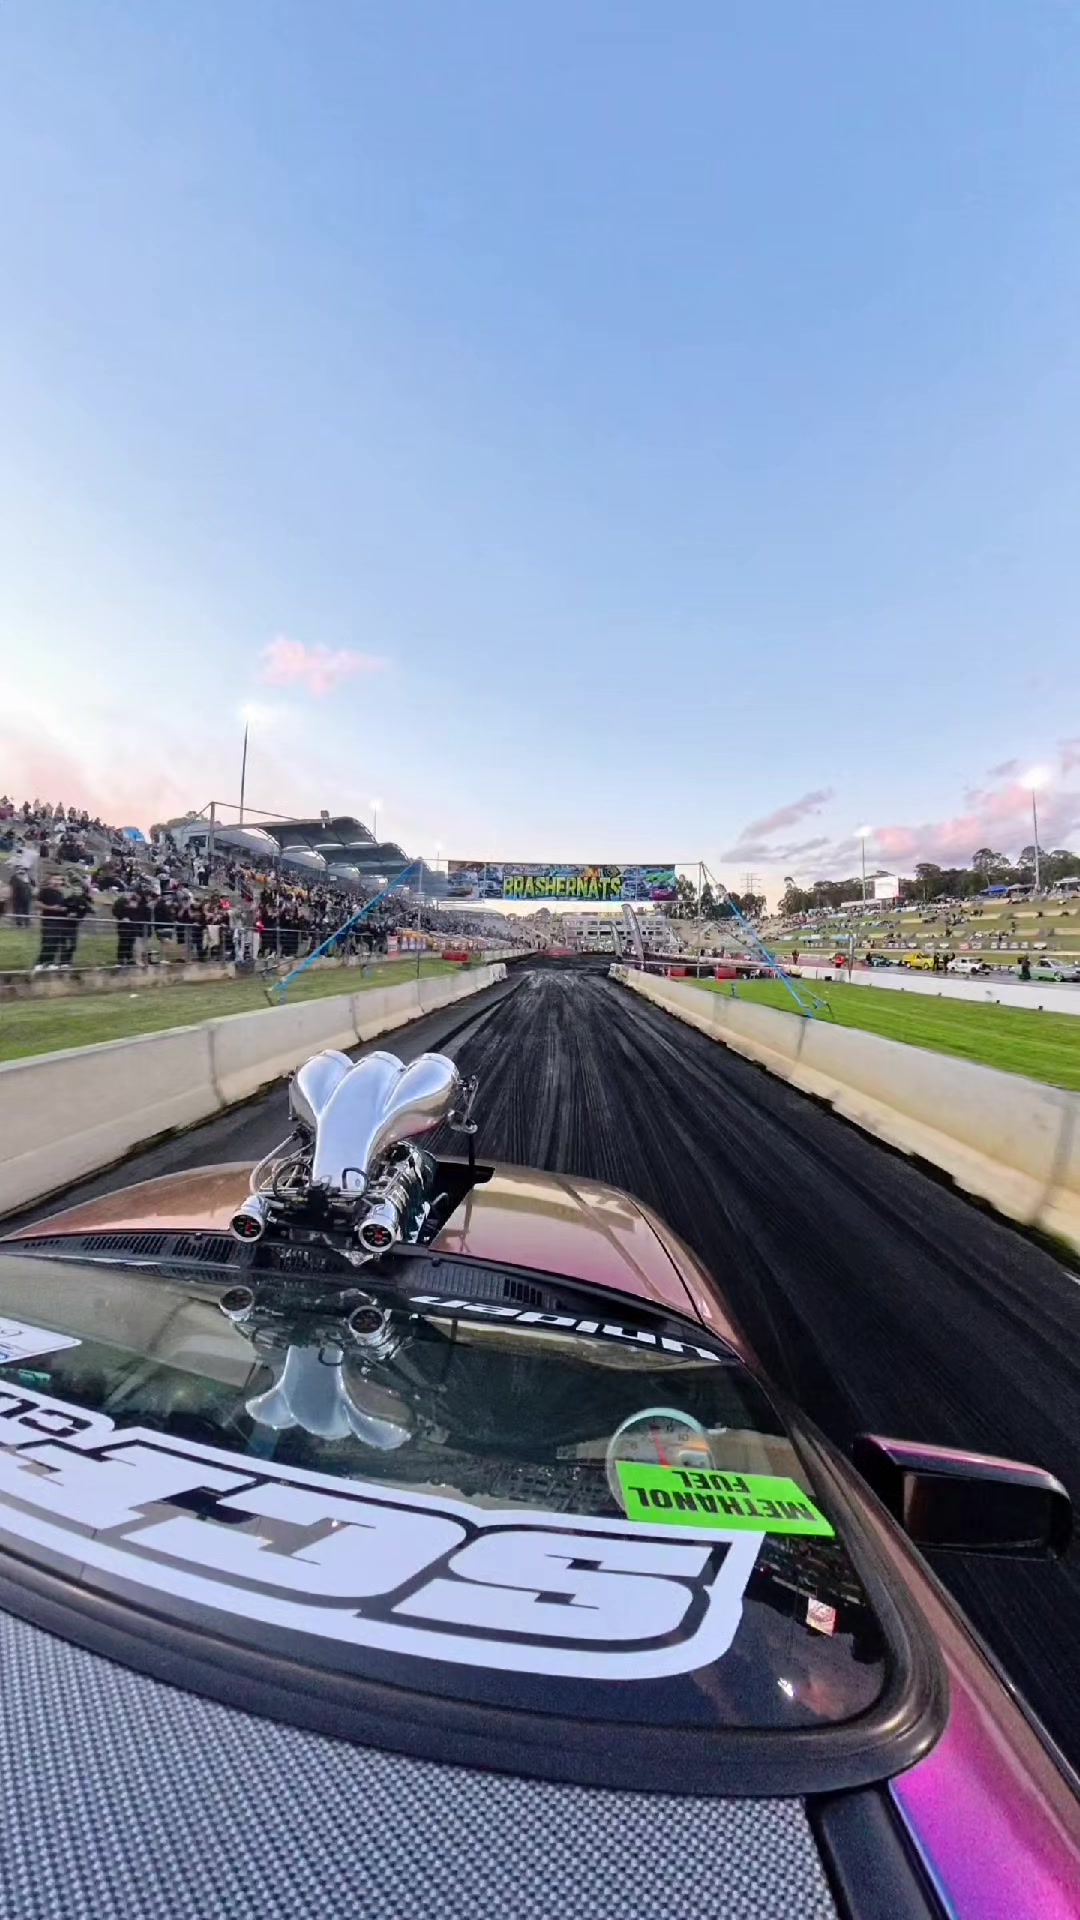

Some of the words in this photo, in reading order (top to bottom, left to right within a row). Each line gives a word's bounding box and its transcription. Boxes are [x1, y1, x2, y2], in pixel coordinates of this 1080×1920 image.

[503, 876, 623, 898] BRASHERNATS
[408, 1295, 722, 1362] uniden
[671, 1470, 752, 1493] FUEL
[628, 1486, 818, 1521] METHANOL
